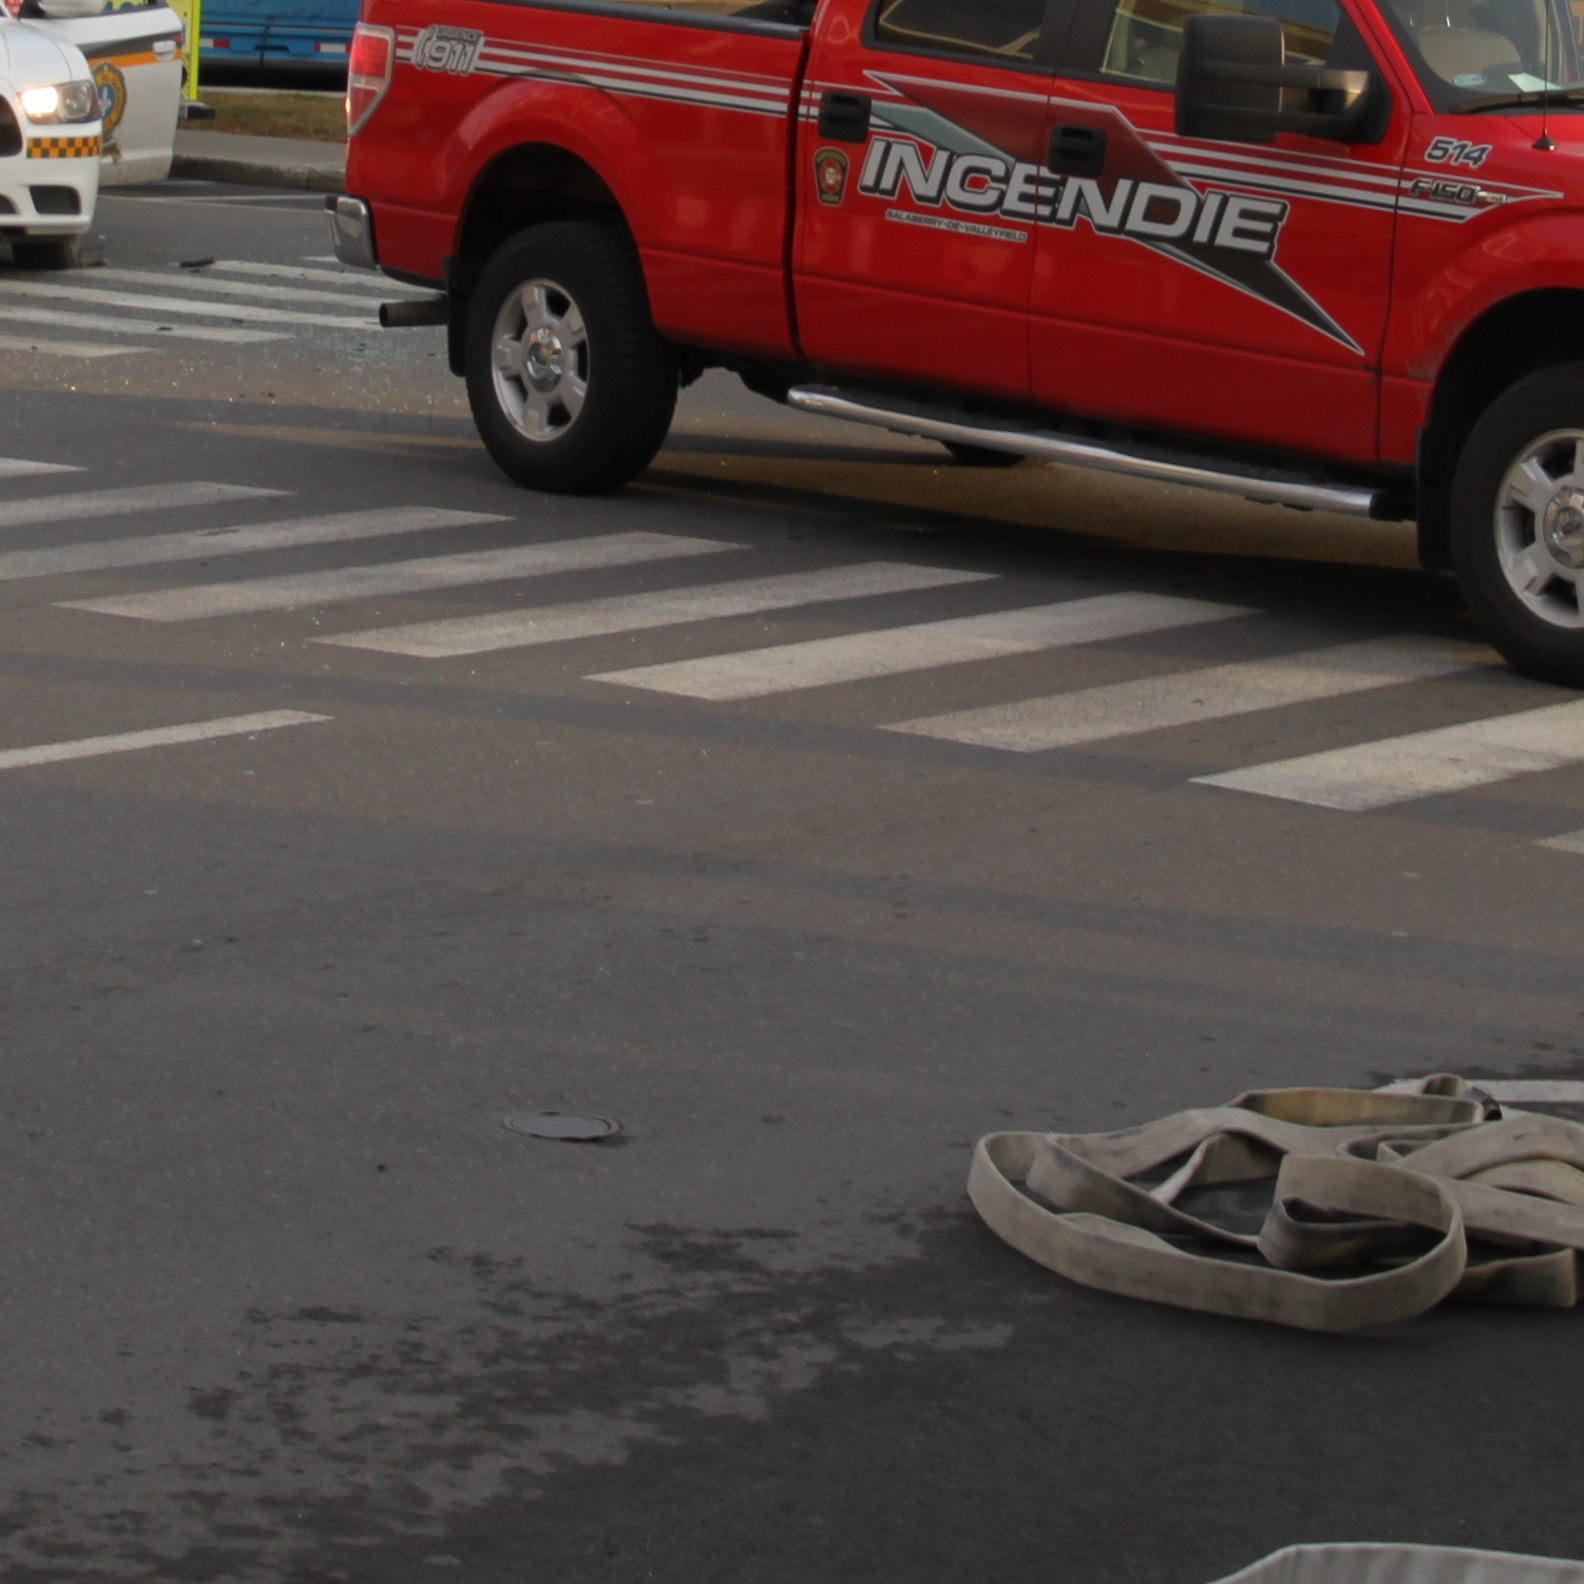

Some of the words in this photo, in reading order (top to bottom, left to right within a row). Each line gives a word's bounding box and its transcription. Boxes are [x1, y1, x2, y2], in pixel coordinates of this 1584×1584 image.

[426, 38, 477, 74] 911
[1424, 135, 1494, 169] 514
[859, 136, 1288, 254] INCENDIE
[886, 209, 1028, 243] SALABERRY-DE-VALLEYFIELD
